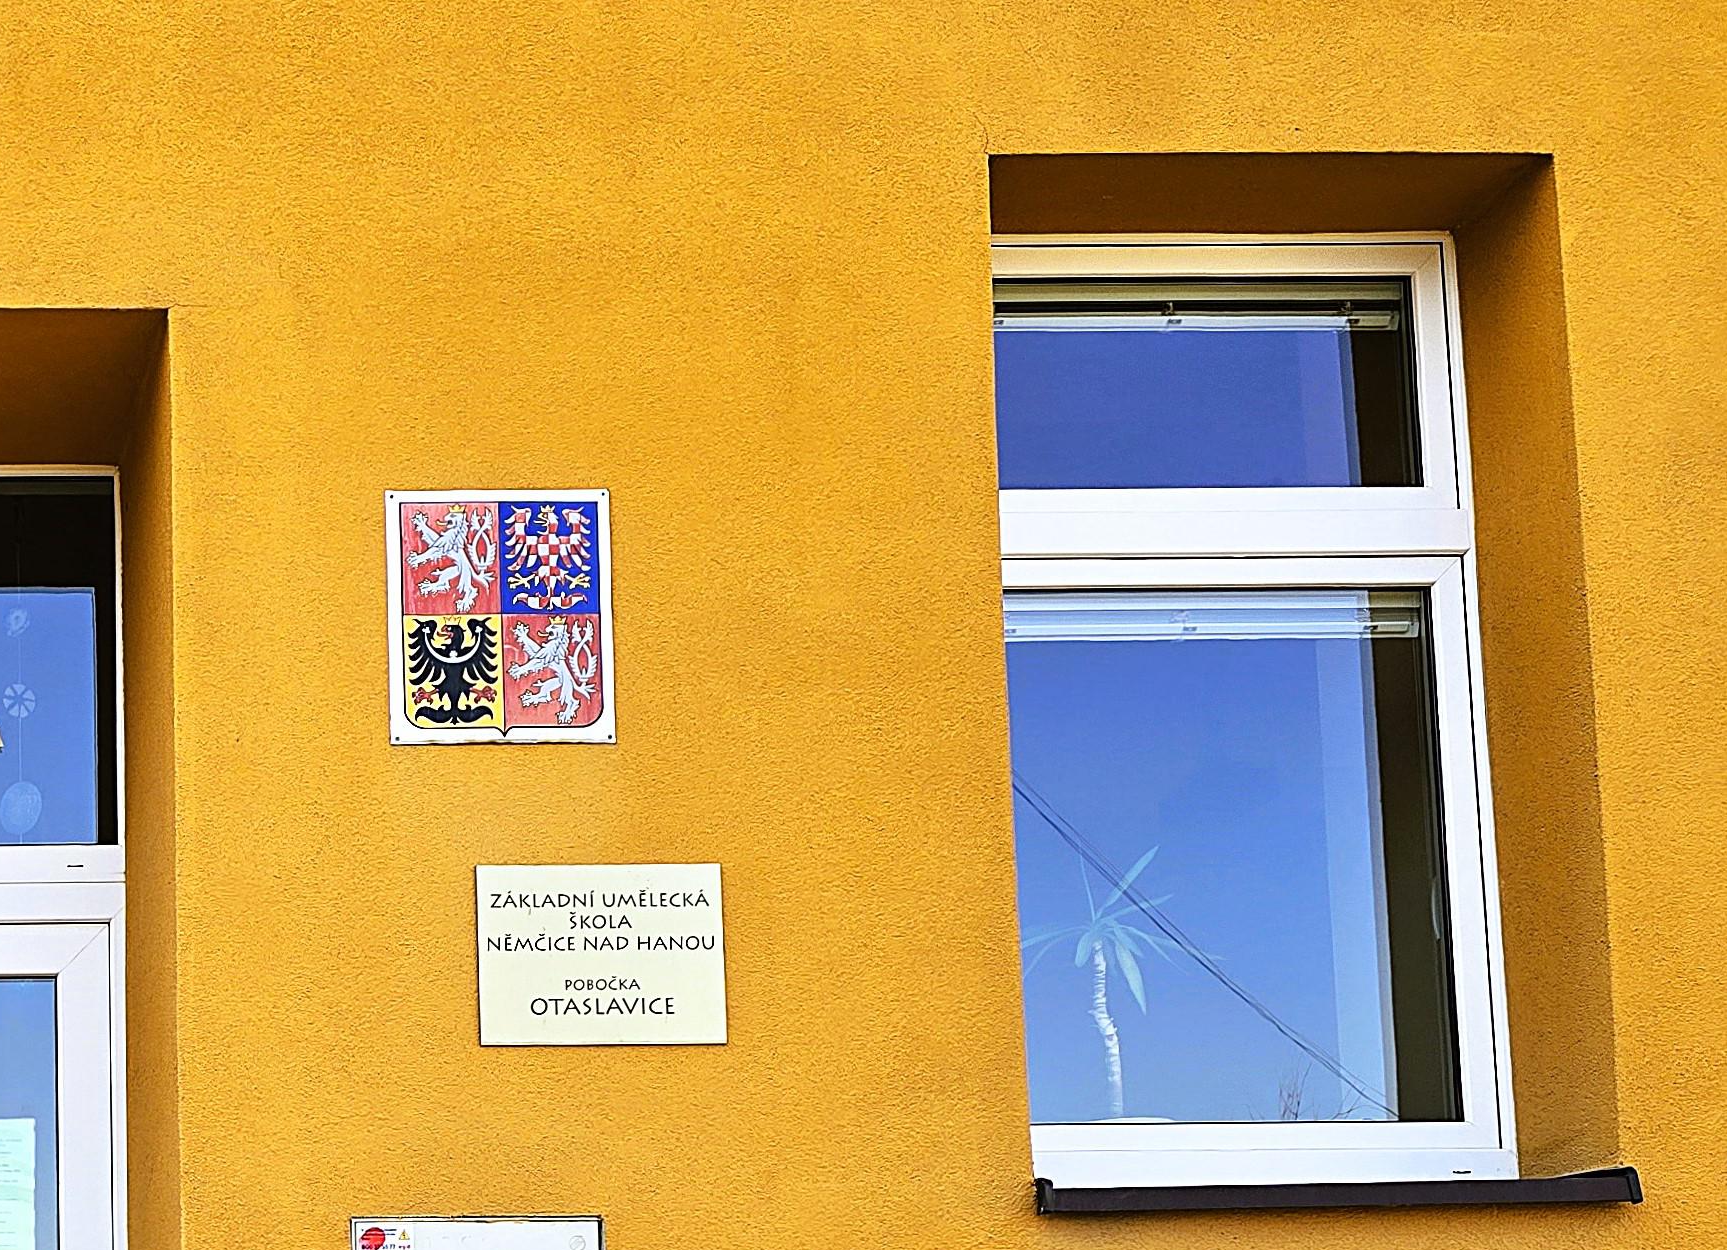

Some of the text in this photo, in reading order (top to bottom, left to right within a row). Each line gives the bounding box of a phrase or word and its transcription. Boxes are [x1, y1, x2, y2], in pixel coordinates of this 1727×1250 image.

[490, 889, 710, 909] ZÁKLADNÍ UMĚLECKÁ
[569, 911, 632, 930] ŠKOLA
[487, 934, 715, 952] NĚMČICE NAD HANOU
[565, 976, 641, 991] POBOČKA
[531, 997, 675, 1016] OTASLAVICE
